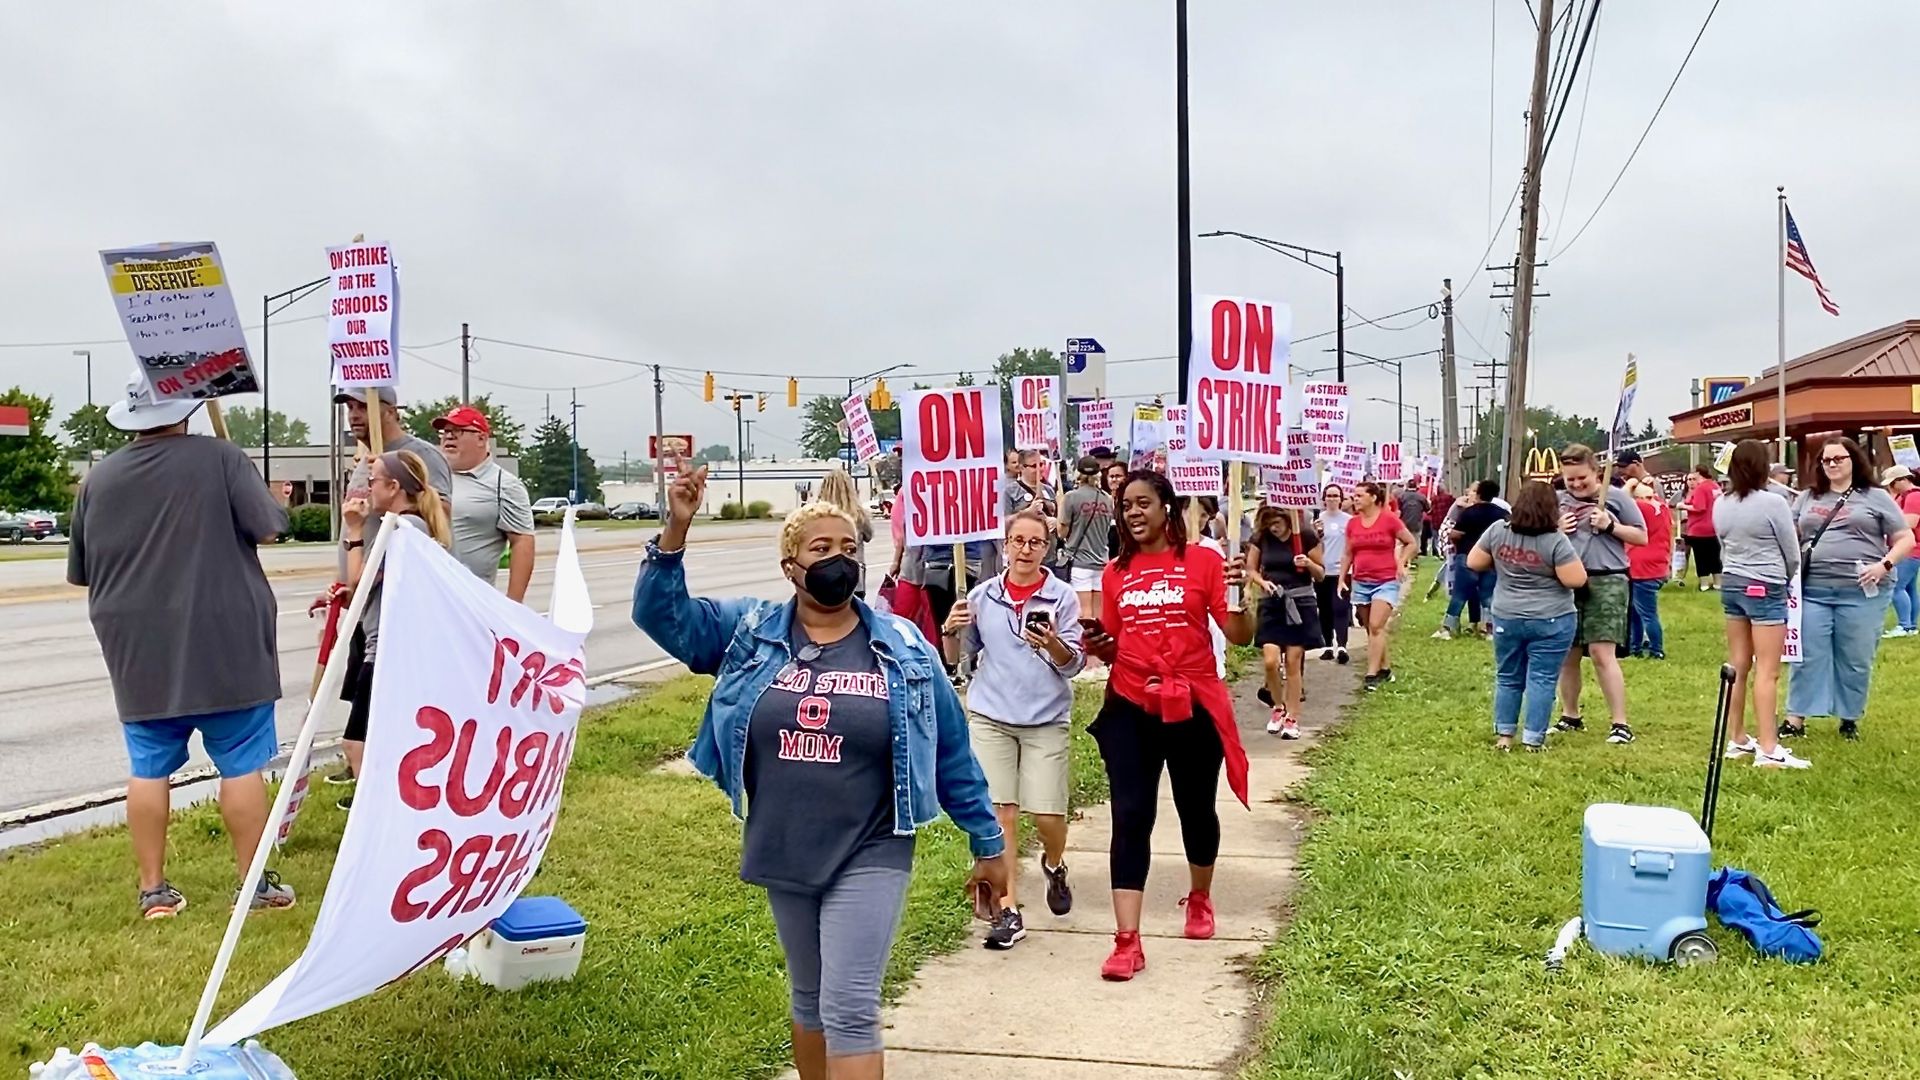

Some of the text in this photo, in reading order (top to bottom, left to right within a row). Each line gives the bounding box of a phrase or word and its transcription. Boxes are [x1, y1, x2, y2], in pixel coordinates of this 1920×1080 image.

[123, 257, 204, 273] COLUMBUS STUDENTS
[330, 246, 388, 270] ON STRIKE
[131, 269, 204, 291] DESERVE:
[339, 273, 376, 290] FOR THE
[331, 295, 388, 316] SCHOOLS
[347, 319, 367, 336] OUR
[1212, 299, 1273, 375] ON
[331, 339, 389, 359] STUDENTS
[1069, 355, 1076, 365] 8
[341, 362, 392, 381] DESERVE!
[156, 373, 184, 395] ON
[1305, 384, 1348, 396] ON STRIKE
[1091, 402, 1113, 412] STRIKE
[1325, 398, 1339, 407] THE
[1167, 409, 1179, 421] ON
[1197, 377, 1282, 456] STRIKE
[1304, 409, 1344, 420] SCHOOLS
[918, 391, 985, 463] ON
[1082, 420, 1112, 431] SCHOOLS
[1312, 433, 1344, 444] UDENTS
[1381, 443, 1399, 461] ON
[1171, 465, 1220, 478] STUDENTS
[1379, 462, 1402, 480] STRIKE
[1175, 480, 1219, 491] DESERVE!
[1266, 481, 1316, 494] STUDENTS
[909, 466, 999, 538] STRIKE
[1270, 493, 1317, 506] DESERVE!
[814, 671, 889, 700] STATE
[796, 695, 831, 730] O
[778, 729, 843, 763] MOM
